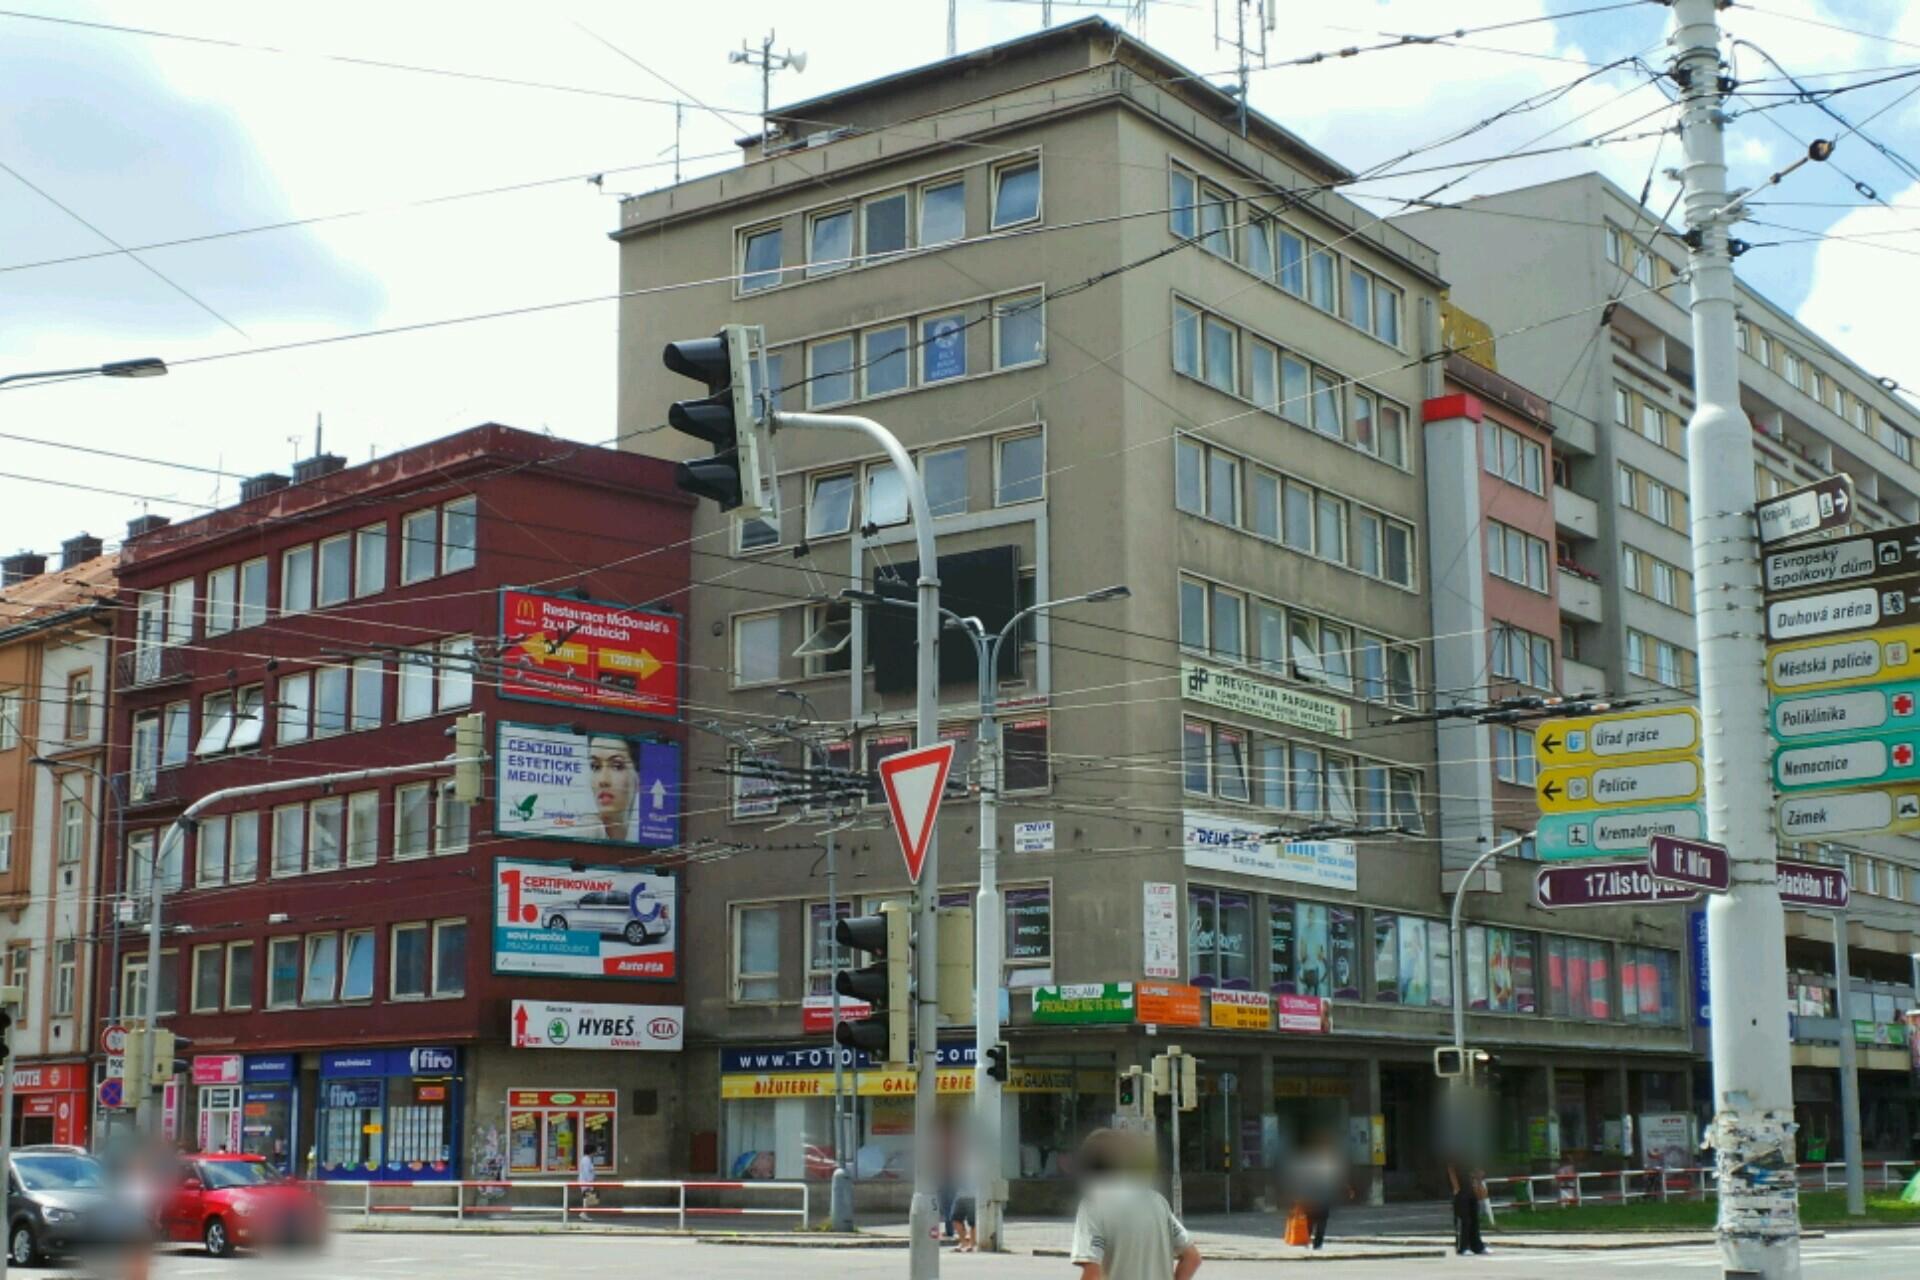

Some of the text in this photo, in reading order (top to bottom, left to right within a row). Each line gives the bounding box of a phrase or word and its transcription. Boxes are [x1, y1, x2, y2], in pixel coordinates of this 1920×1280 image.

[1773, 547, 1839, 570] Evropský
[1773, 559, 1873, 587] spolkový dům
[542, 602, 604, 623] Restaurace
[1777, 601, 1872, 628] Duhová aréna
[1778, 650, 1873, 677] Městská policie
[1781, 708, 1847, 727] Poliklinika
[1596, 728, 1659, 747] Úřad práce
[508, 739, 574, 757] CENTRUM
[508, 755, 582, 774] ESTETICKÉ
[1783, 757, 1848, 776] Nemocnice
[507, 769, 573, 787] MEDICÍNY
[1598, 777, 1638, 793] Policie
[1787, 808, 1827, 826] Zámek
[1776, 869, 1838, 900] alackého tř.
[499, 869, 614, 923] 1. CERTIFIKOVANÝ
[577, 1015, 635, 1037] HYBEŠ
[651, 1022, 675, 1035] KIA
[419, 1050, 453, 1069] firo
[753, 1079, 820, 1095] BIŽUTERIE
[882, 1075, 973, 1092] GALTERIE
[329, 1085, 357, 1107] firo
